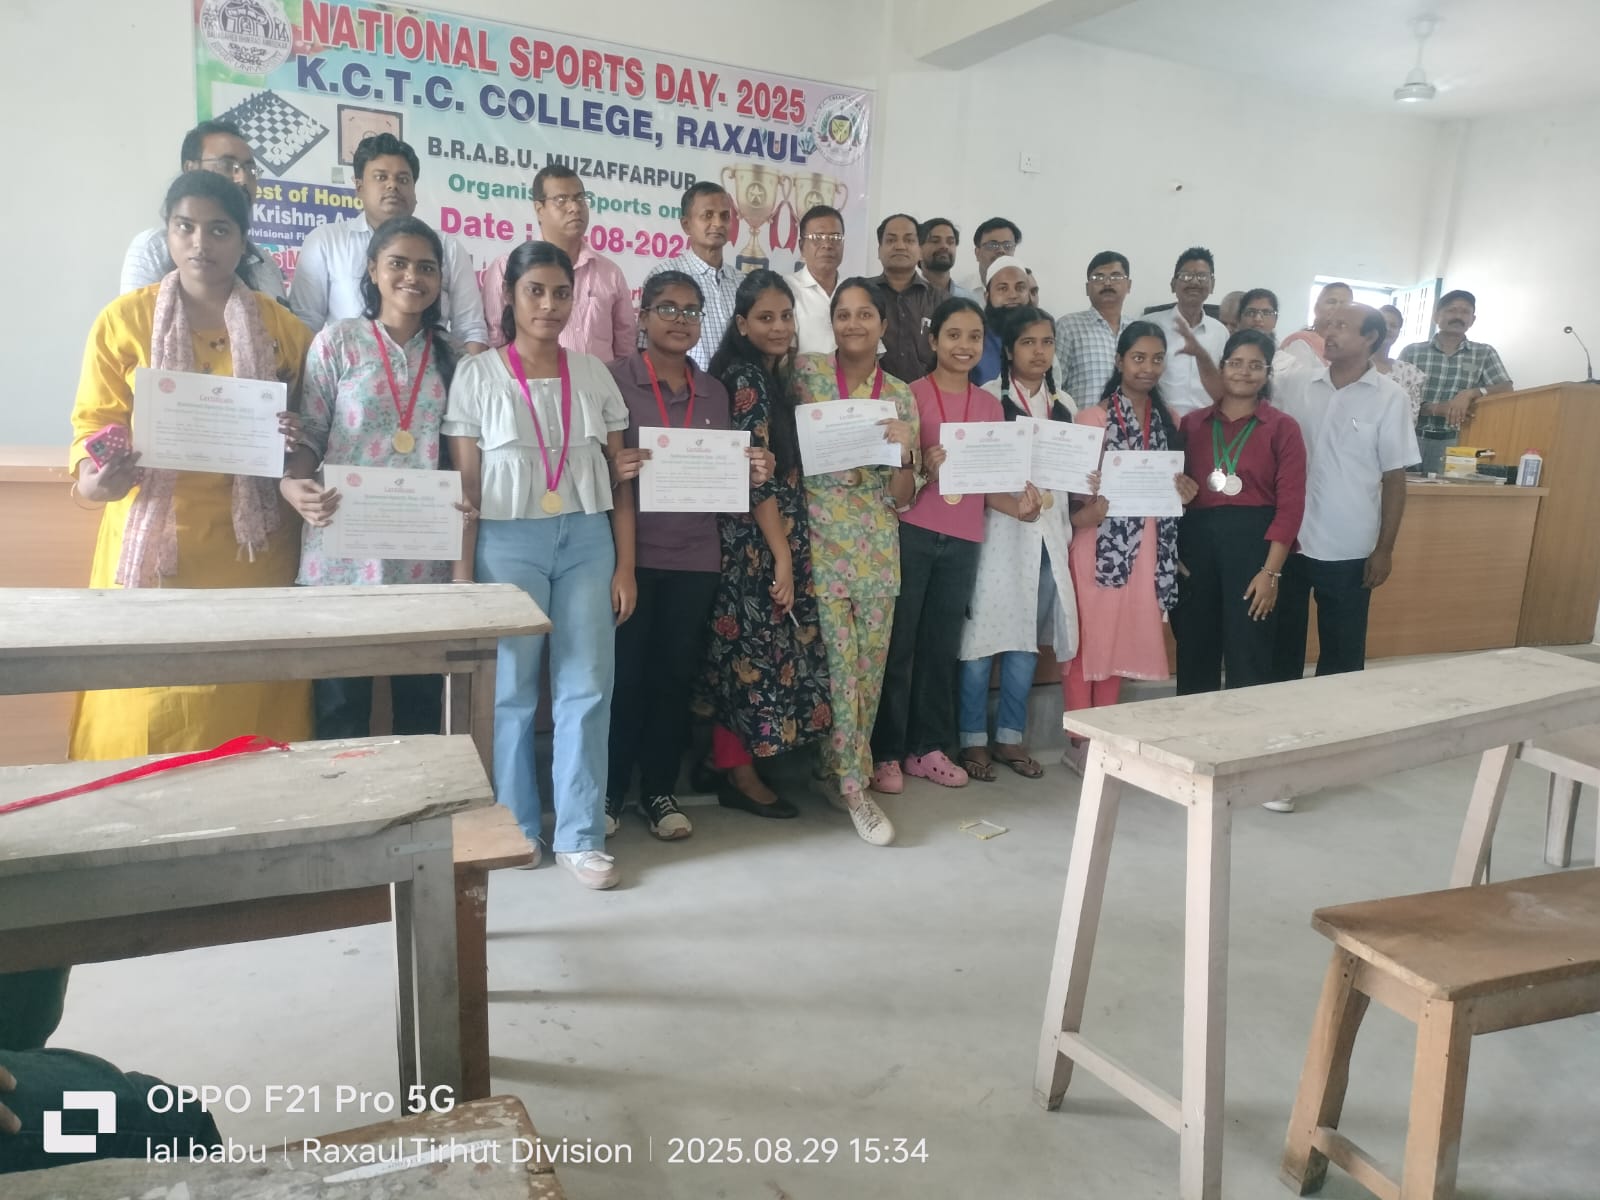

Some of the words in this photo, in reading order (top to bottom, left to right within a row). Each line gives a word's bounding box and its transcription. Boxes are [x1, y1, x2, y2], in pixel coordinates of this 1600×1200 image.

[302, 2, 498, 72] NATIONAL
[509, 36, 644, 97] SPORTS
[736, 79, 806, 125] 2025
[296, 54, 464, 111] K.C.T.C.
[479, 86, 663, 147] COLLEGE,
[676, 115, 807, 164] RAXAUL
[427, 136, 539, 170] B.R.A.B.U.
[252, 203, 327, 227] Krishna
[288, 187, 308, 203] of
[314, 188, 364, 210] Hono
[440, 206, 514, 241] Date
